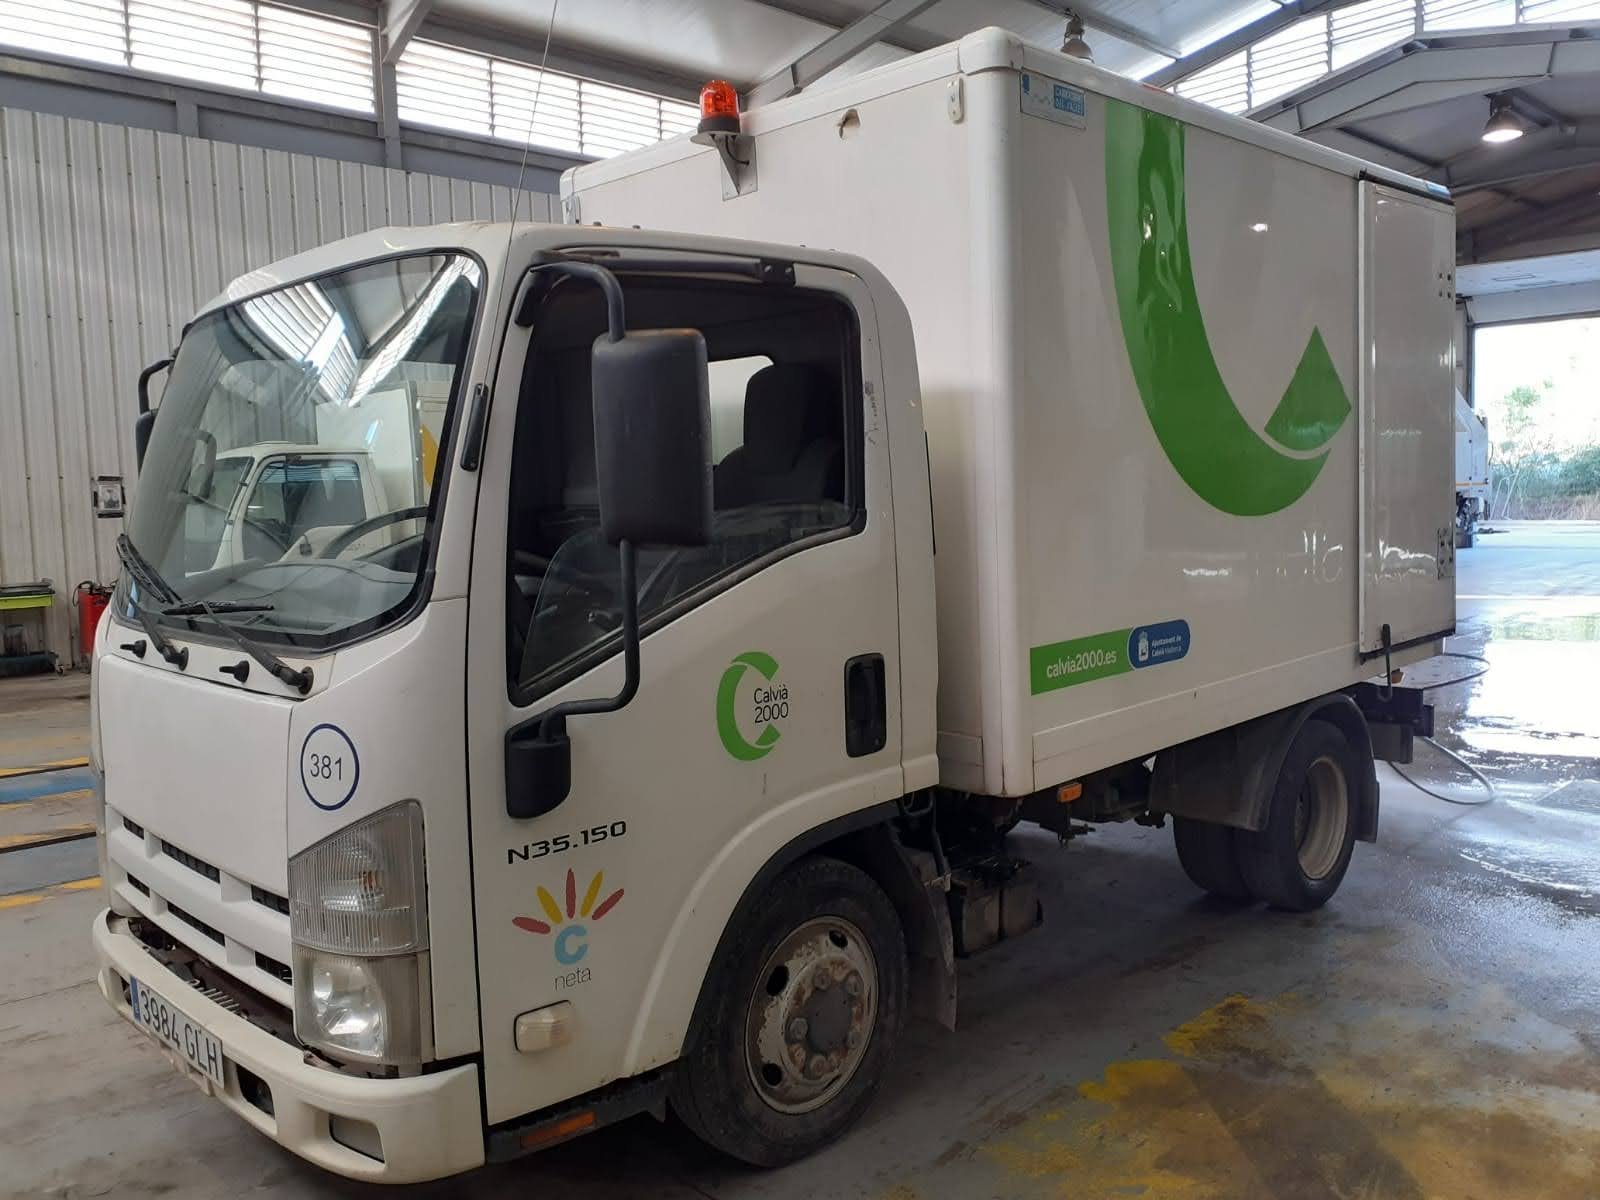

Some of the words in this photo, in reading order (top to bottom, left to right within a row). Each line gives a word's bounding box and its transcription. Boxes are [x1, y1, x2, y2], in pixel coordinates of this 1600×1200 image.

[1046, 649, 1118, 679] calvia2000.es
[753, 684, 789, 705] Calvià
[754, 702, 789, 723] 2000
[310, 753, 342, 781] 381
[507, 821, 627, 864] N35.150
[554, 967, 592, 991] neta
[140, 989, 180, 1051] 3984
[184, 1023, 220, 1082] GLH
